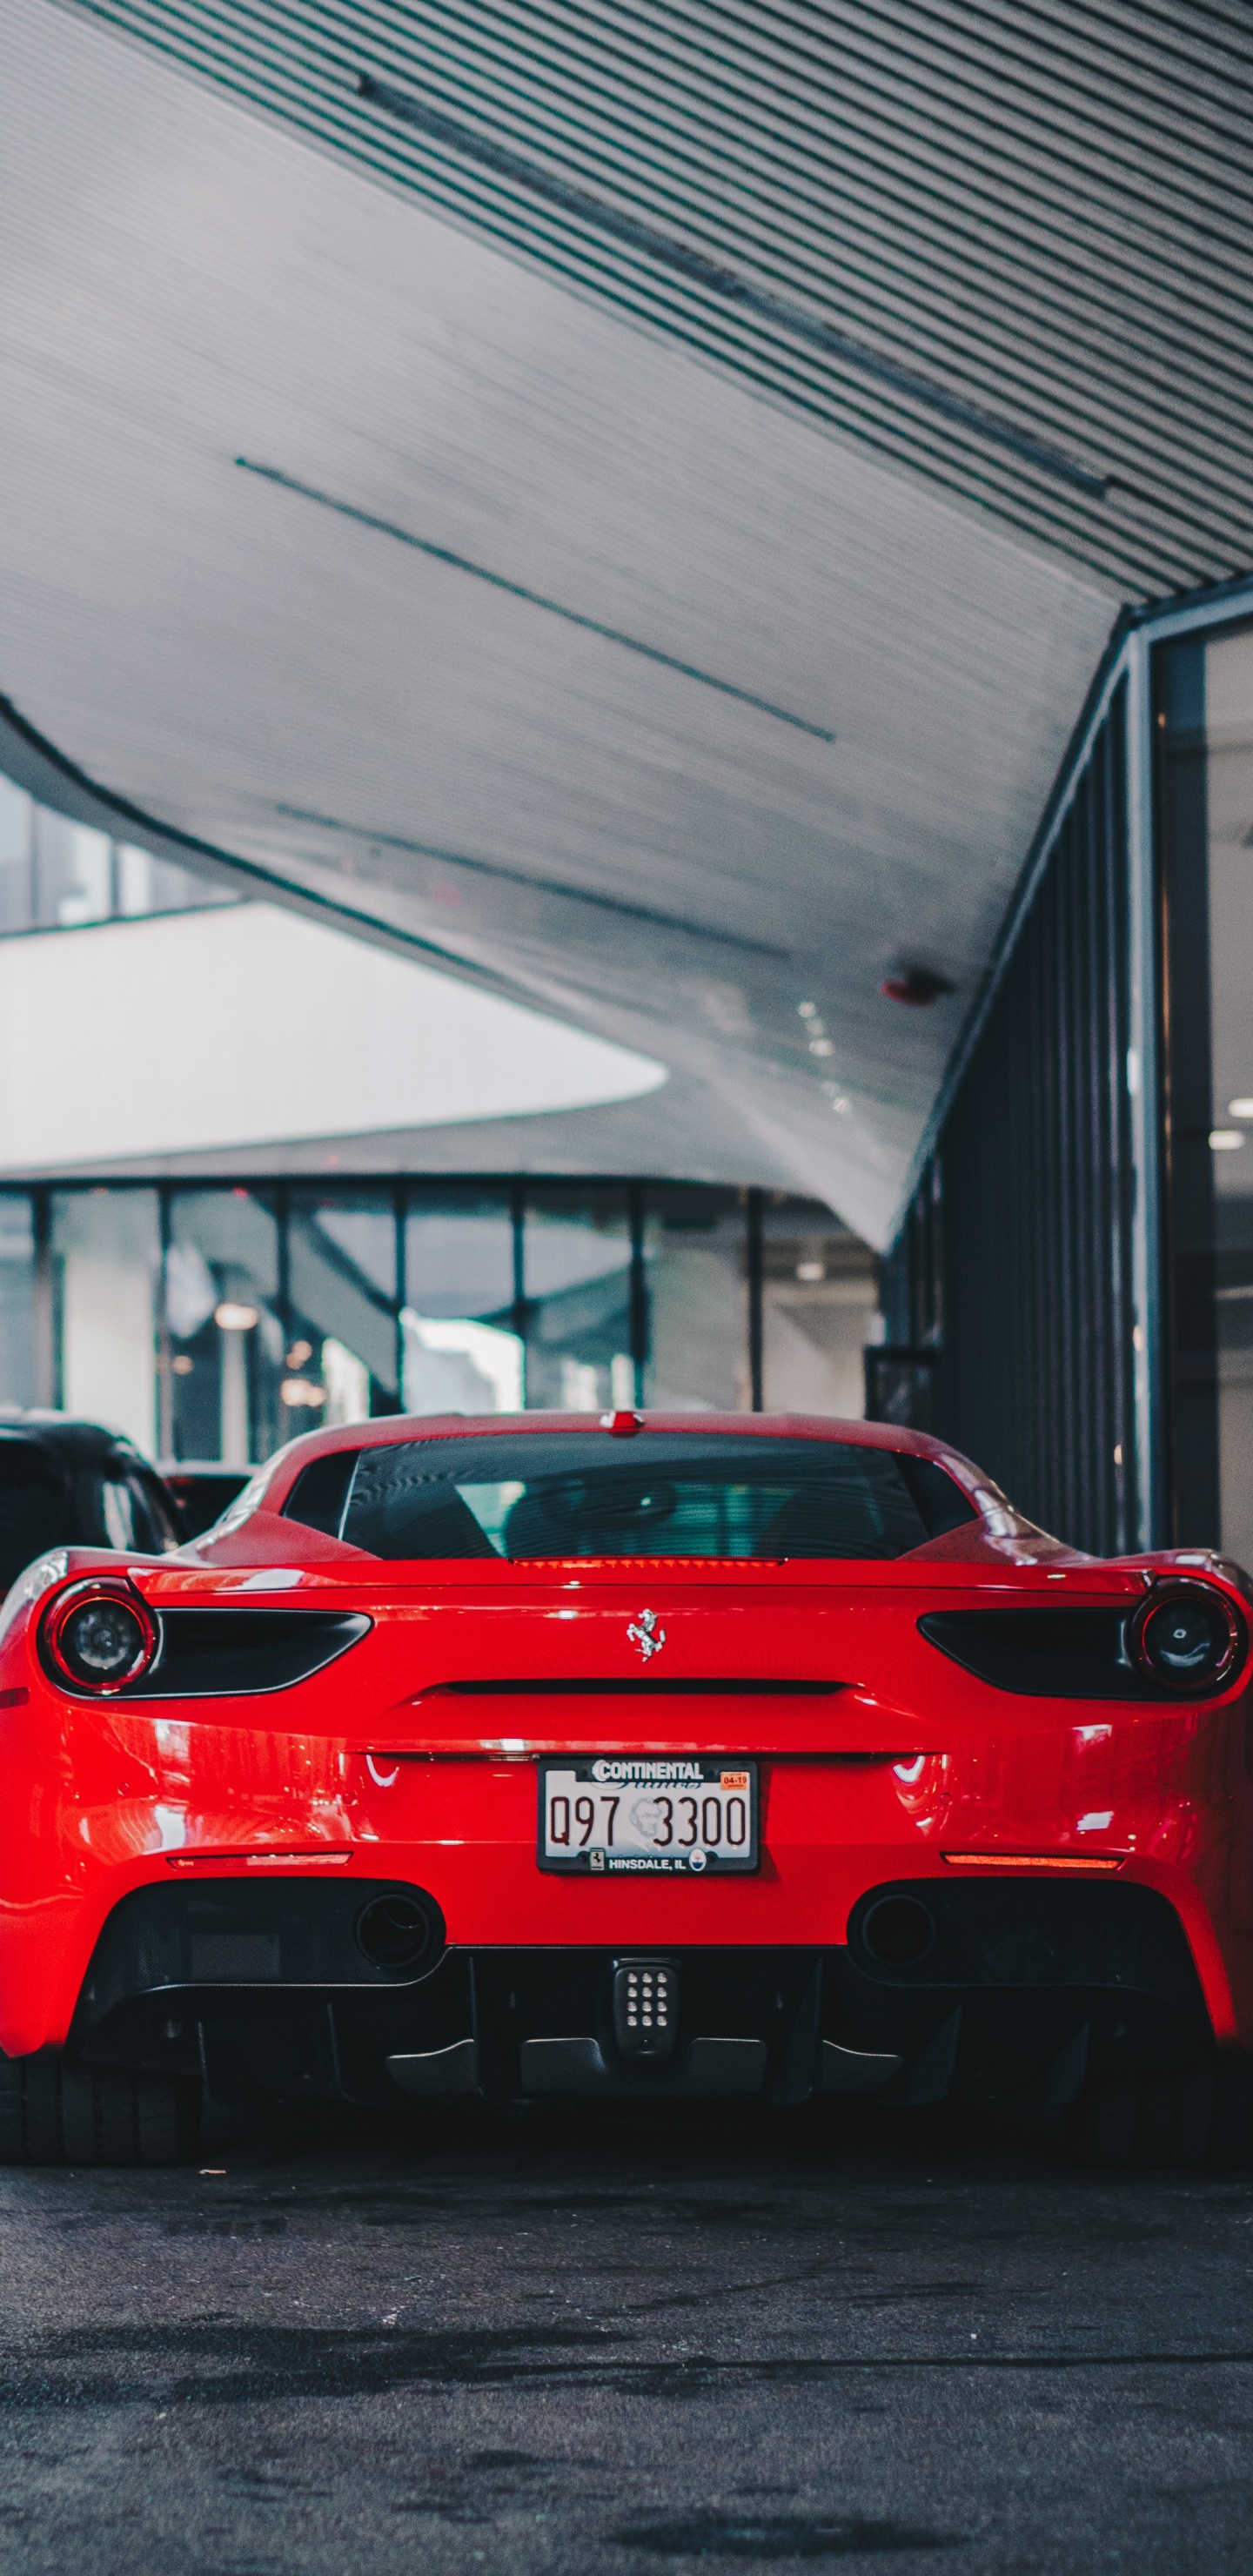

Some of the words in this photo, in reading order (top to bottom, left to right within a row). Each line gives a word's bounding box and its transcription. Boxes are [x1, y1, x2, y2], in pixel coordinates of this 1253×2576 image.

[593, 1760, 704, 1781] CONTINENTAL
[551, 1796, 620, 1846] Q97
[653, 1796, 746, 1847] 3300
[609, 1859, 673, 1870] HINSDALE,
[674, 1860, 687, 1869] IL
